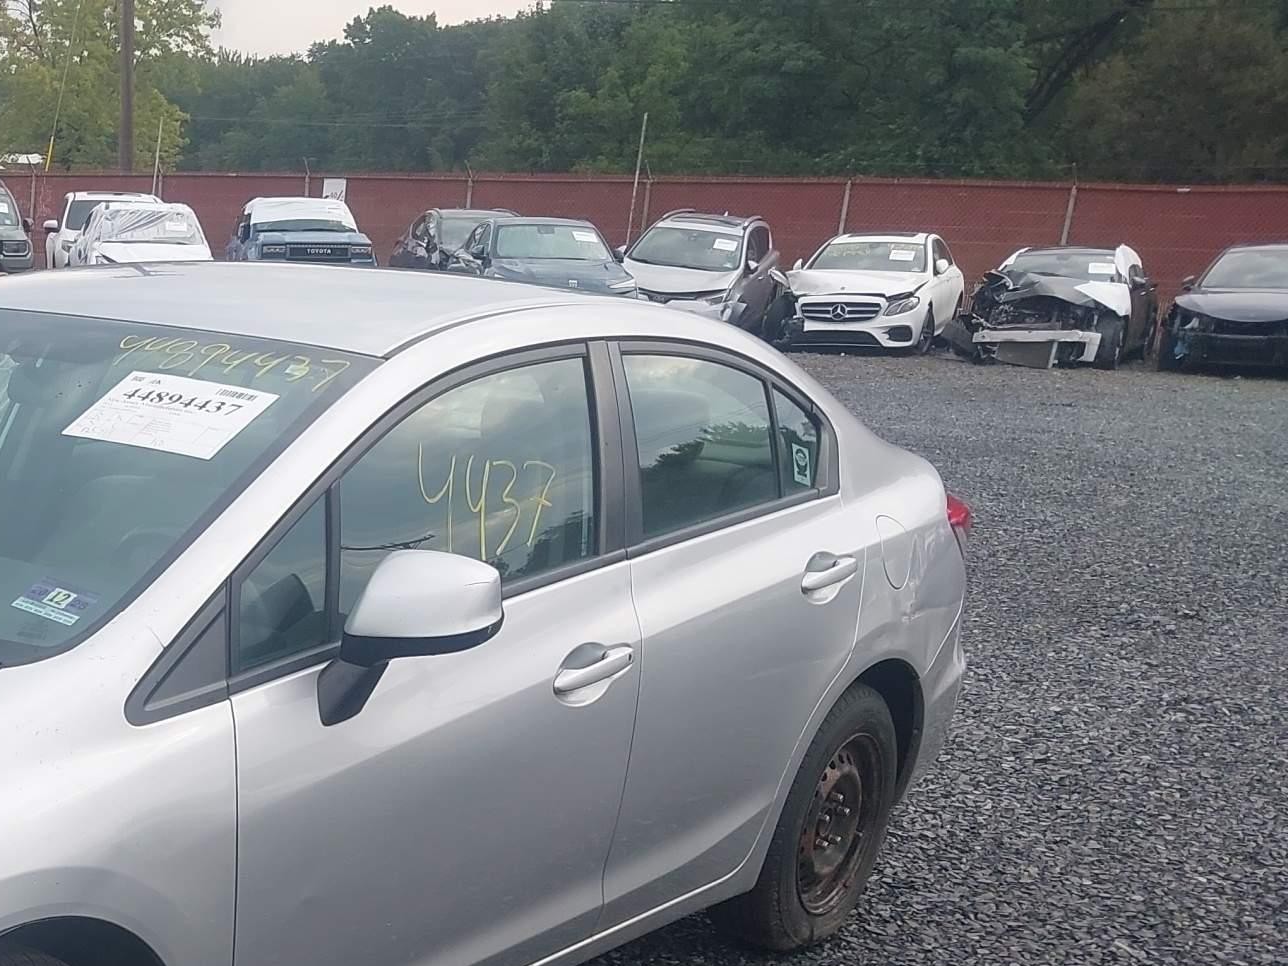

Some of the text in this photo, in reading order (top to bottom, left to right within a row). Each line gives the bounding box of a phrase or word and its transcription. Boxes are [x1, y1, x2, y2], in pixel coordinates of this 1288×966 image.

[114, 335, 350, 393] 44894437
[123, 387, 244, 416] 44894437
[418, 441, 556, 562] 4437
[46, 590, 71, 606] 12
